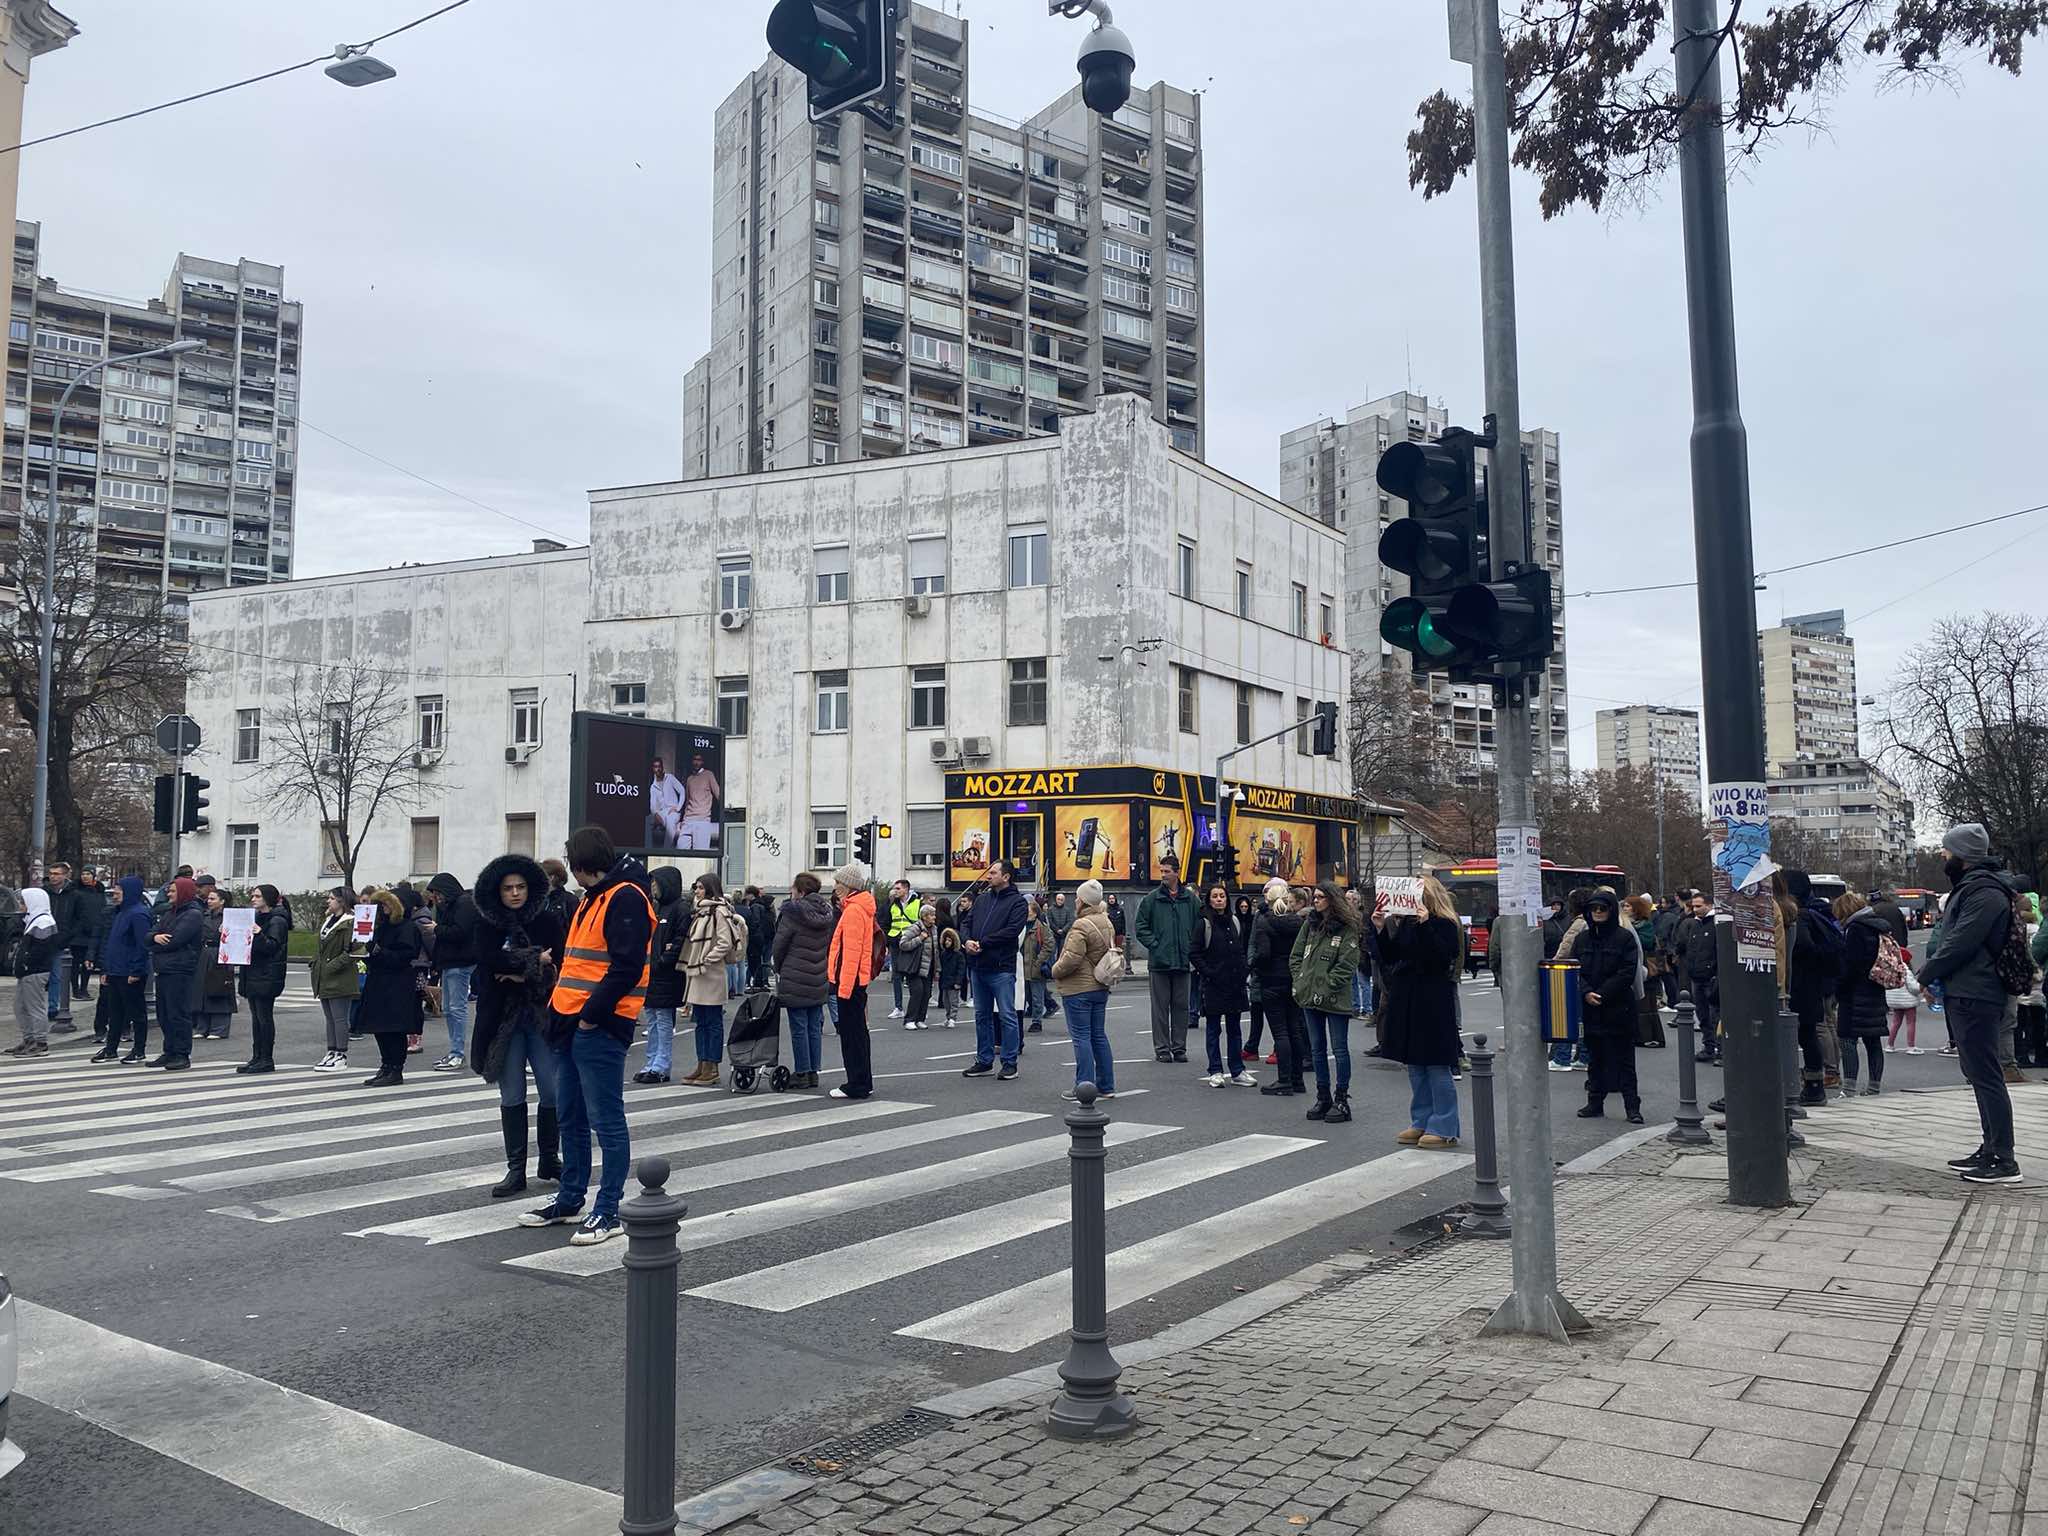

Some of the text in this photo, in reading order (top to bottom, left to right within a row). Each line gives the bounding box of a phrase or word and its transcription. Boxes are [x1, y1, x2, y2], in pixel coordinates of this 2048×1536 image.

[694, 738, 710, 748] 1299
[595, 782, 639, 796] TUDORS
[965, 772, 1079, 796] MOZZART
[1248, 787, 1297, 811] MOZZART
[1714, 803, 1734, 816] NA
[1736, 800, 1748, 816] 8
